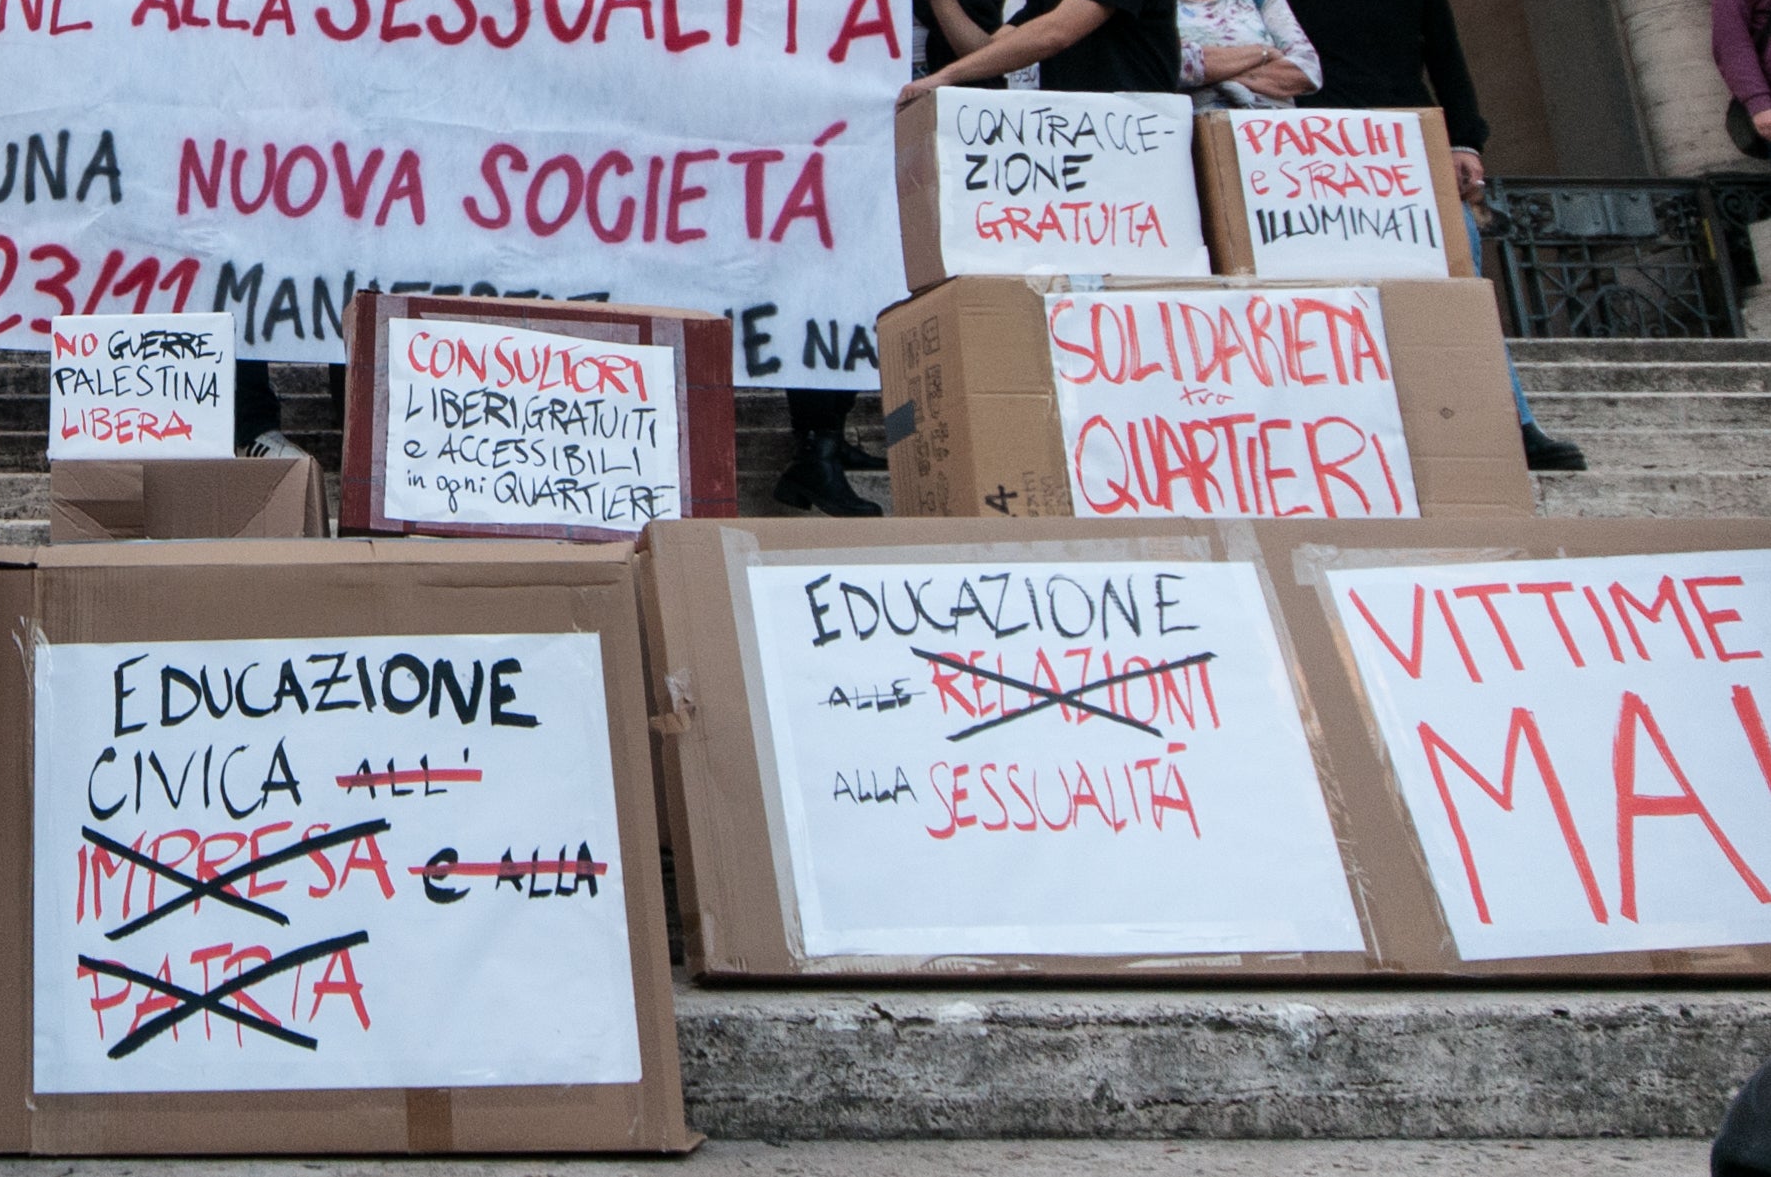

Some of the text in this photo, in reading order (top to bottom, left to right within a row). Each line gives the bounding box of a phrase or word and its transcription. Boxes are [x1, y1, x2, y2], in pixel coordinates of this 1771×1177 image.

[1239, 116, 1406, 158] PARCHI
[176, 137, 426, 228] NUOVA
[965, 152, 1093, 196] ZIONE
[1251, 161, 1420, 198] e STRADE
[976, 202, 1167, 247] GRATUITA
[1256, 204, 1436, 248] ILLUMINATI
[53, 330, 223, 364] NO GUERRE,
[408, 332, 647, 402] CONSULTORI
[52, 364, 220, 407] PALESTINA
[1181, 387, 1231, 405] tra
[61, 407, 192, 444] LIBERA
[404, 433, 641, 481] e ACCESSIBILI
[1075, 413, 1402, 515] QUARTIERI
[408, 471, 675, 522] in ogni QUARTIERE
[805, 573, 1198, 647] EDUCAZIONE
[1349, 575, 1763, 683] VITTIME
[114, 652, 542, 738] EDUCAZIONE
[827, 646, 1220, 731] ALLE RELAZIONI
[88, 737, 302, 821] CIVICA
[833, 767, 916, 803] ALLA
[76, 820, 599, 925] IMPRESA e ALLA
[77, 942, 371, 1049] PATRIA
